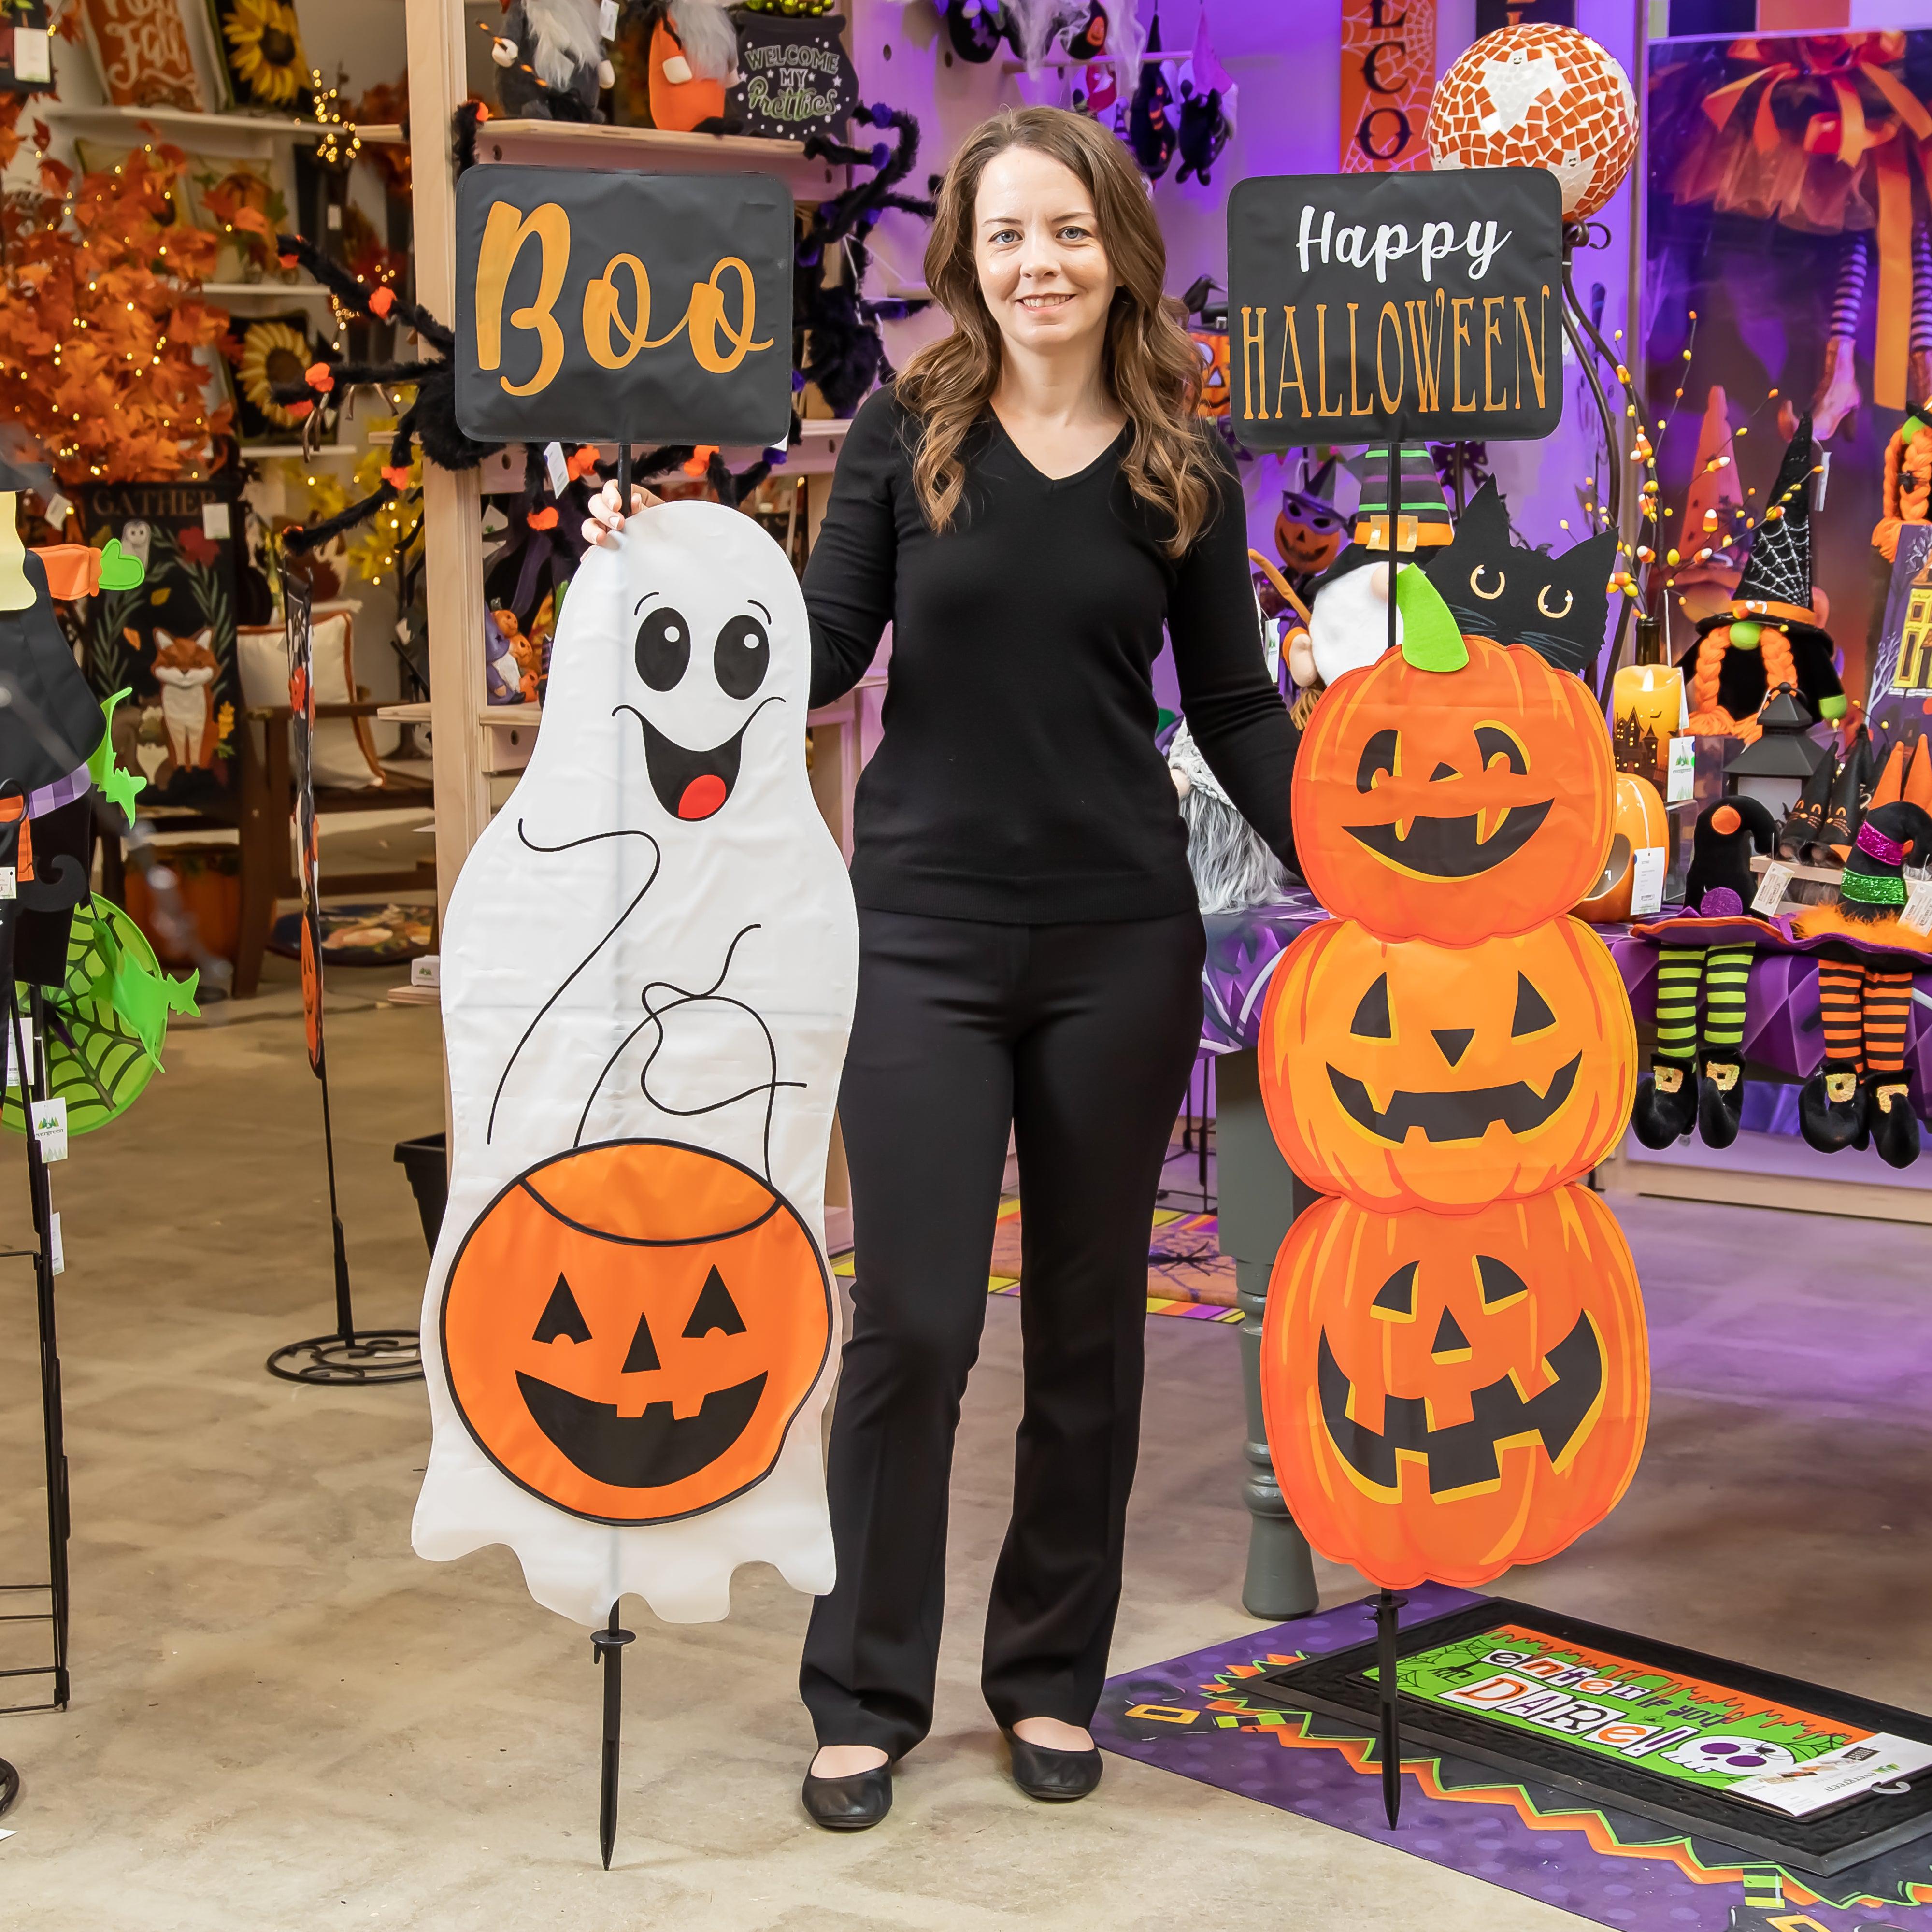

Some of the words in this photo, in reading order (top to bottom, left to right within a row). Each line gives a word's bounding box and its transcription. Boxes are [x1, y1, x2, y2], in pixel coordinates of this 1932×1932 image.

[744, 44, 840, 74] WELCOME
[779, 68, 808, 87] MY
[748, 76, 837, 121] Pretties
[1296, 205, 1512, 283] Happy
[475, 201, 773, 396] Boo
[1241, 284, 1550, 420] HALLOWEEN
[1489, 1652, 1646, 1697] enter
[1823, 1772, 1877, 1792] evergreen
